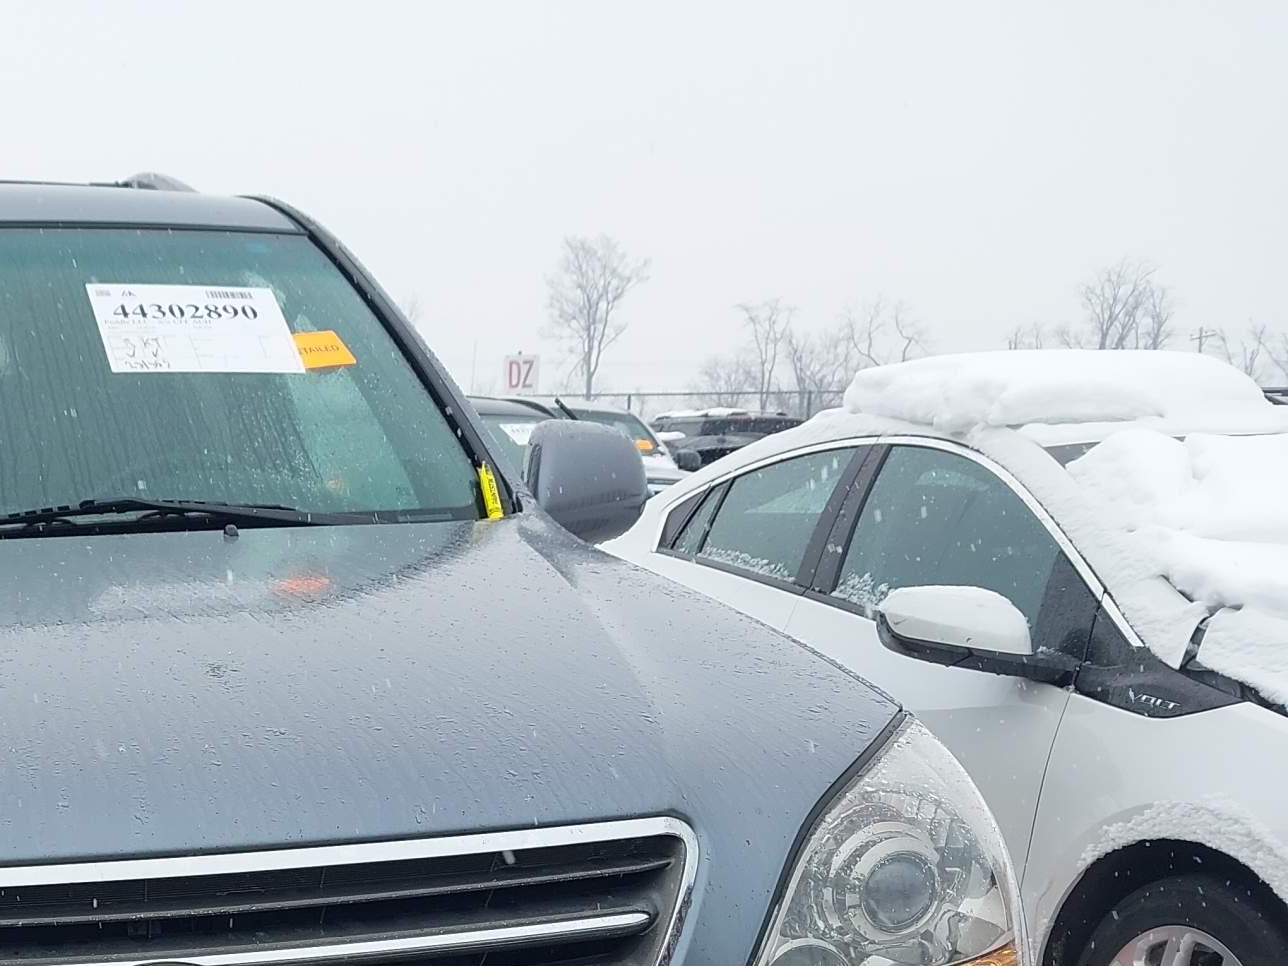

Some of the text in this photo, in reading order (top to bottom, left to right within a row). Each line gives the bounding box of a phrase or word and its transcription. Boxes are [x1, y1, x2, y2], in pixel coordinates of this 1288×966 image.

[113, 304, 258, 320] 44302890
[509, 360, 534, 388] DZ
[1129, 688, 1181, 710] VOLT
